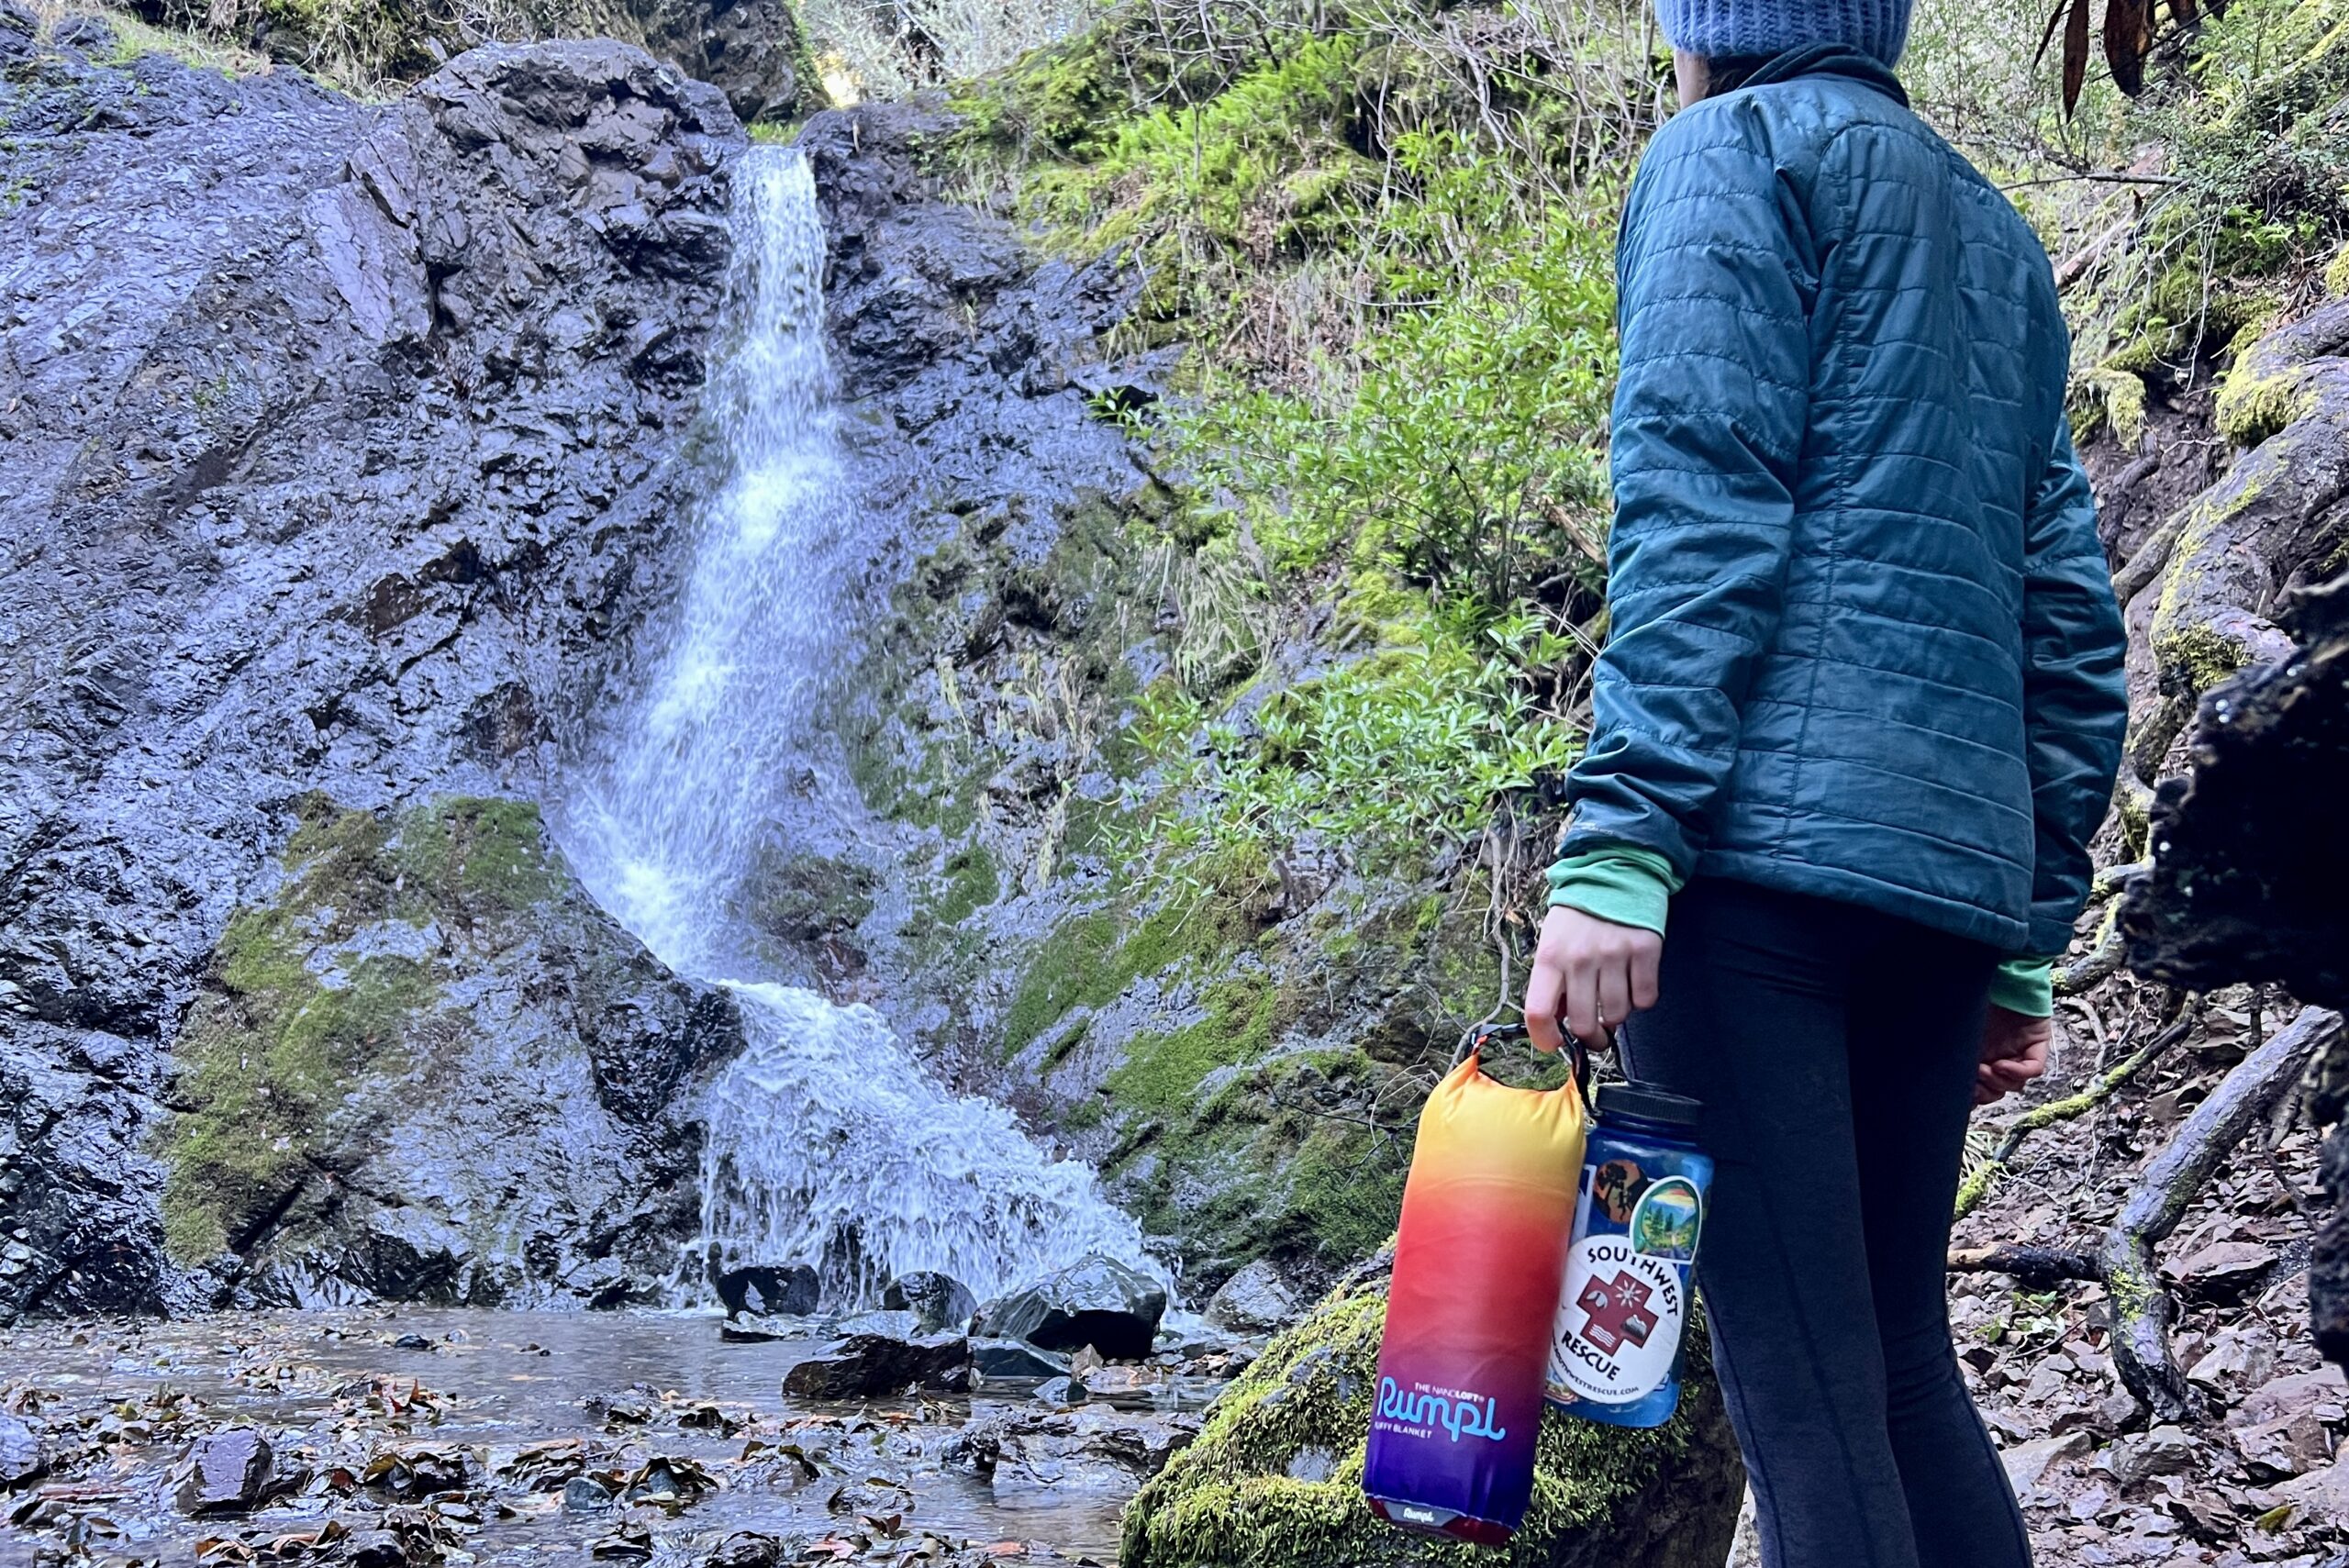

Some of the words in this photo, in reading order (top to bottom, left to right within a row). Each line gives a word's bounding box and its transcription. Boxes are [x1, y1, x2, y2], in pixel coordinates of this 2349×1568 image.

[1561, 1329, 1620, 1381] RESCUE
[1415, 1382, 1431, 1394] THE
[1376, 1376, 1506, 1442] Rumpl
[1393, 1423, 1432, 1439] BLANKET
